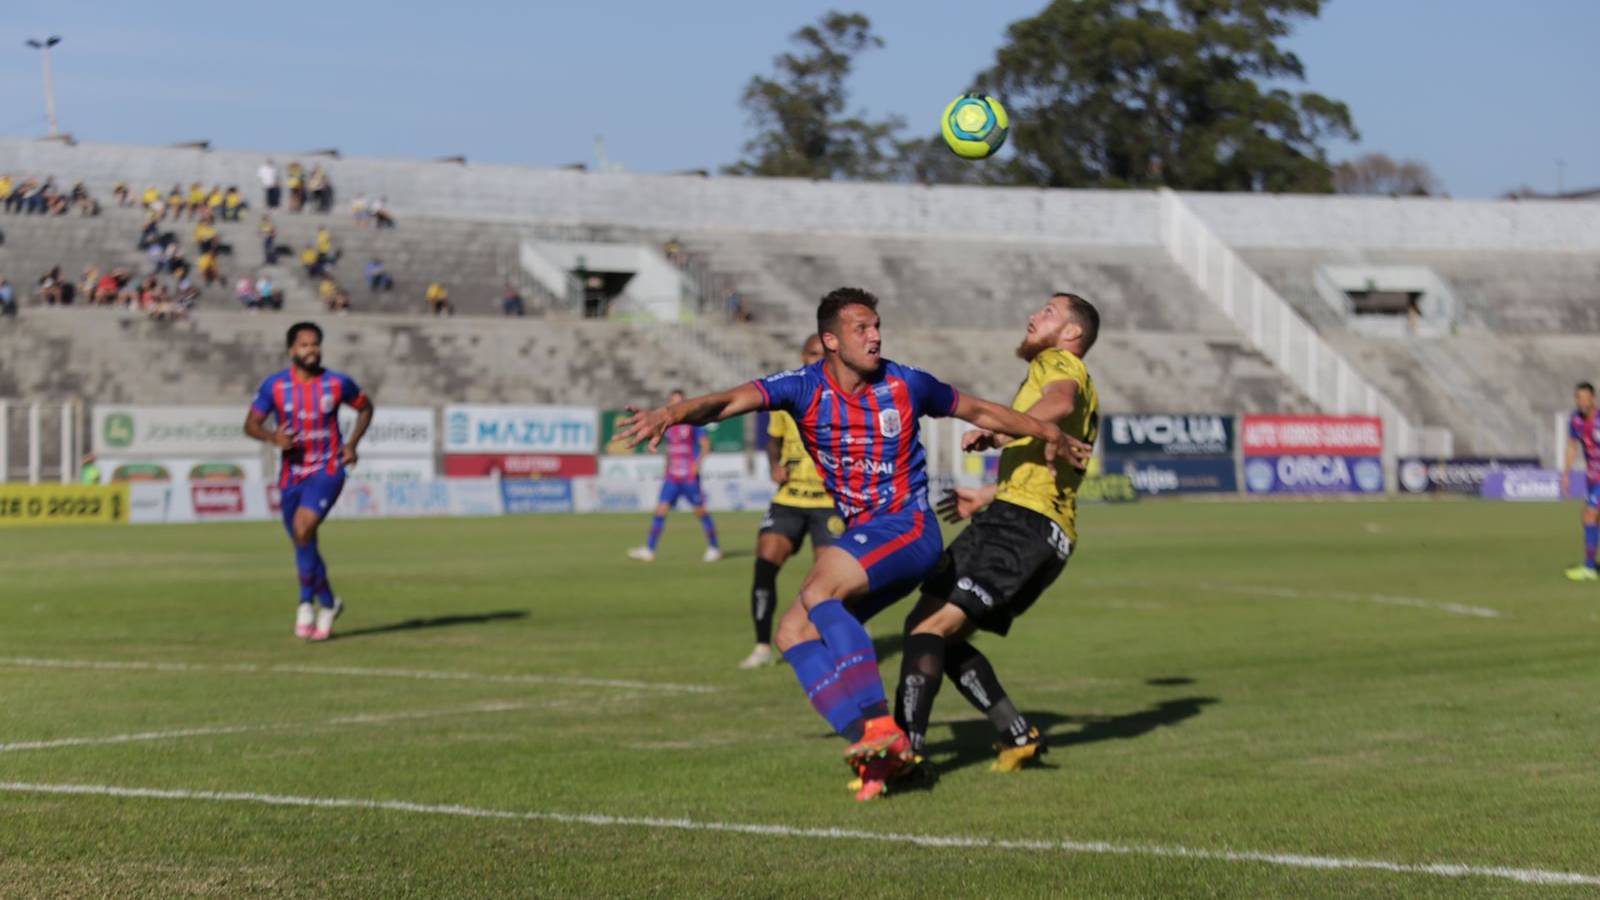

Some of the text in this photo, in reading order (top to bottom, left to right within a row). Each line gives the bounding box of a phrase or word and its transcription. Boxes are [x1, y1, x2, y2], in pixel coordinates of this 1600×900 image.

[478, 418, 594, 444] MAZUTTI
[1111, 416, 1227, 444] EVOLUA
[1277, 454, 1351, 486] ORCA
[49, 494, 102, 515] 2022
